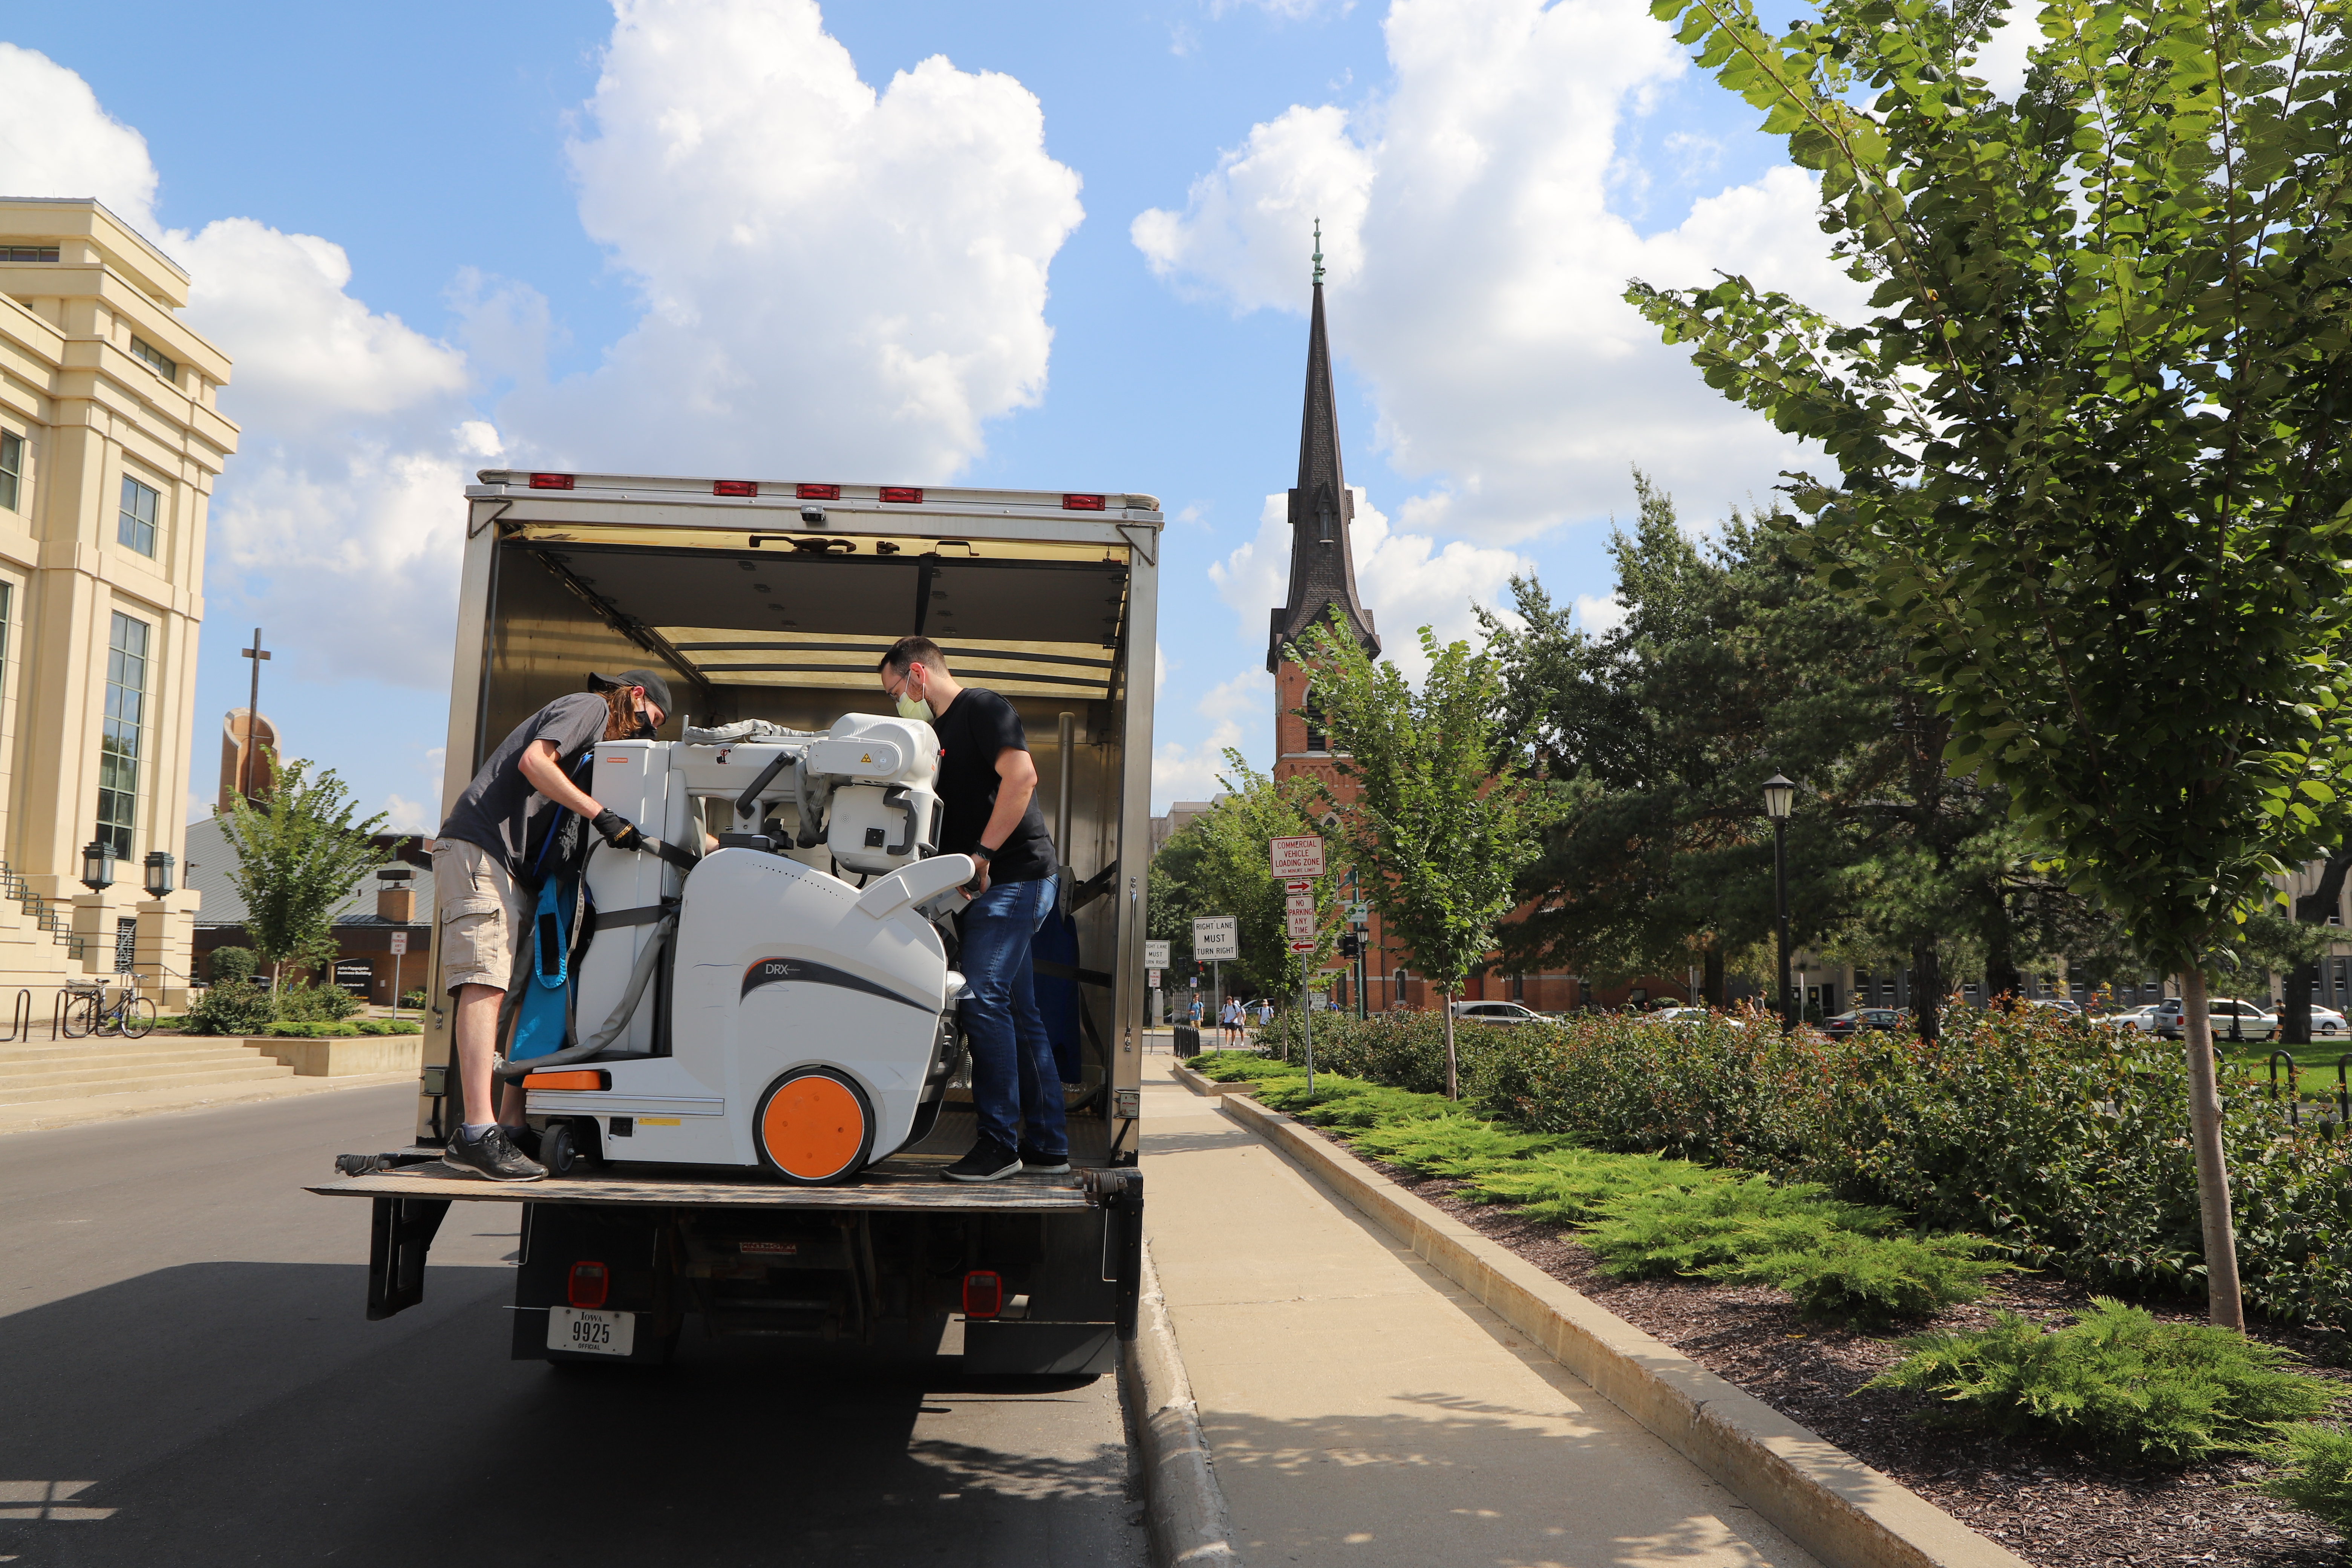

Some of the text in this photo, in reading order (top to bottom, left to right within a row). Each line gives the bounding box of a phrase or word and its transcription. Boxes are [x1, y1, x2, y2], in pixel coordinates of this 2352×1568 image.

[1277, 840, 1317, 849] COMMERCIAL
[1204, 934, 1225, 943] MUST
[766, 964, 788, 975] DRX
[573, 1321, 610, 1344] 9925
